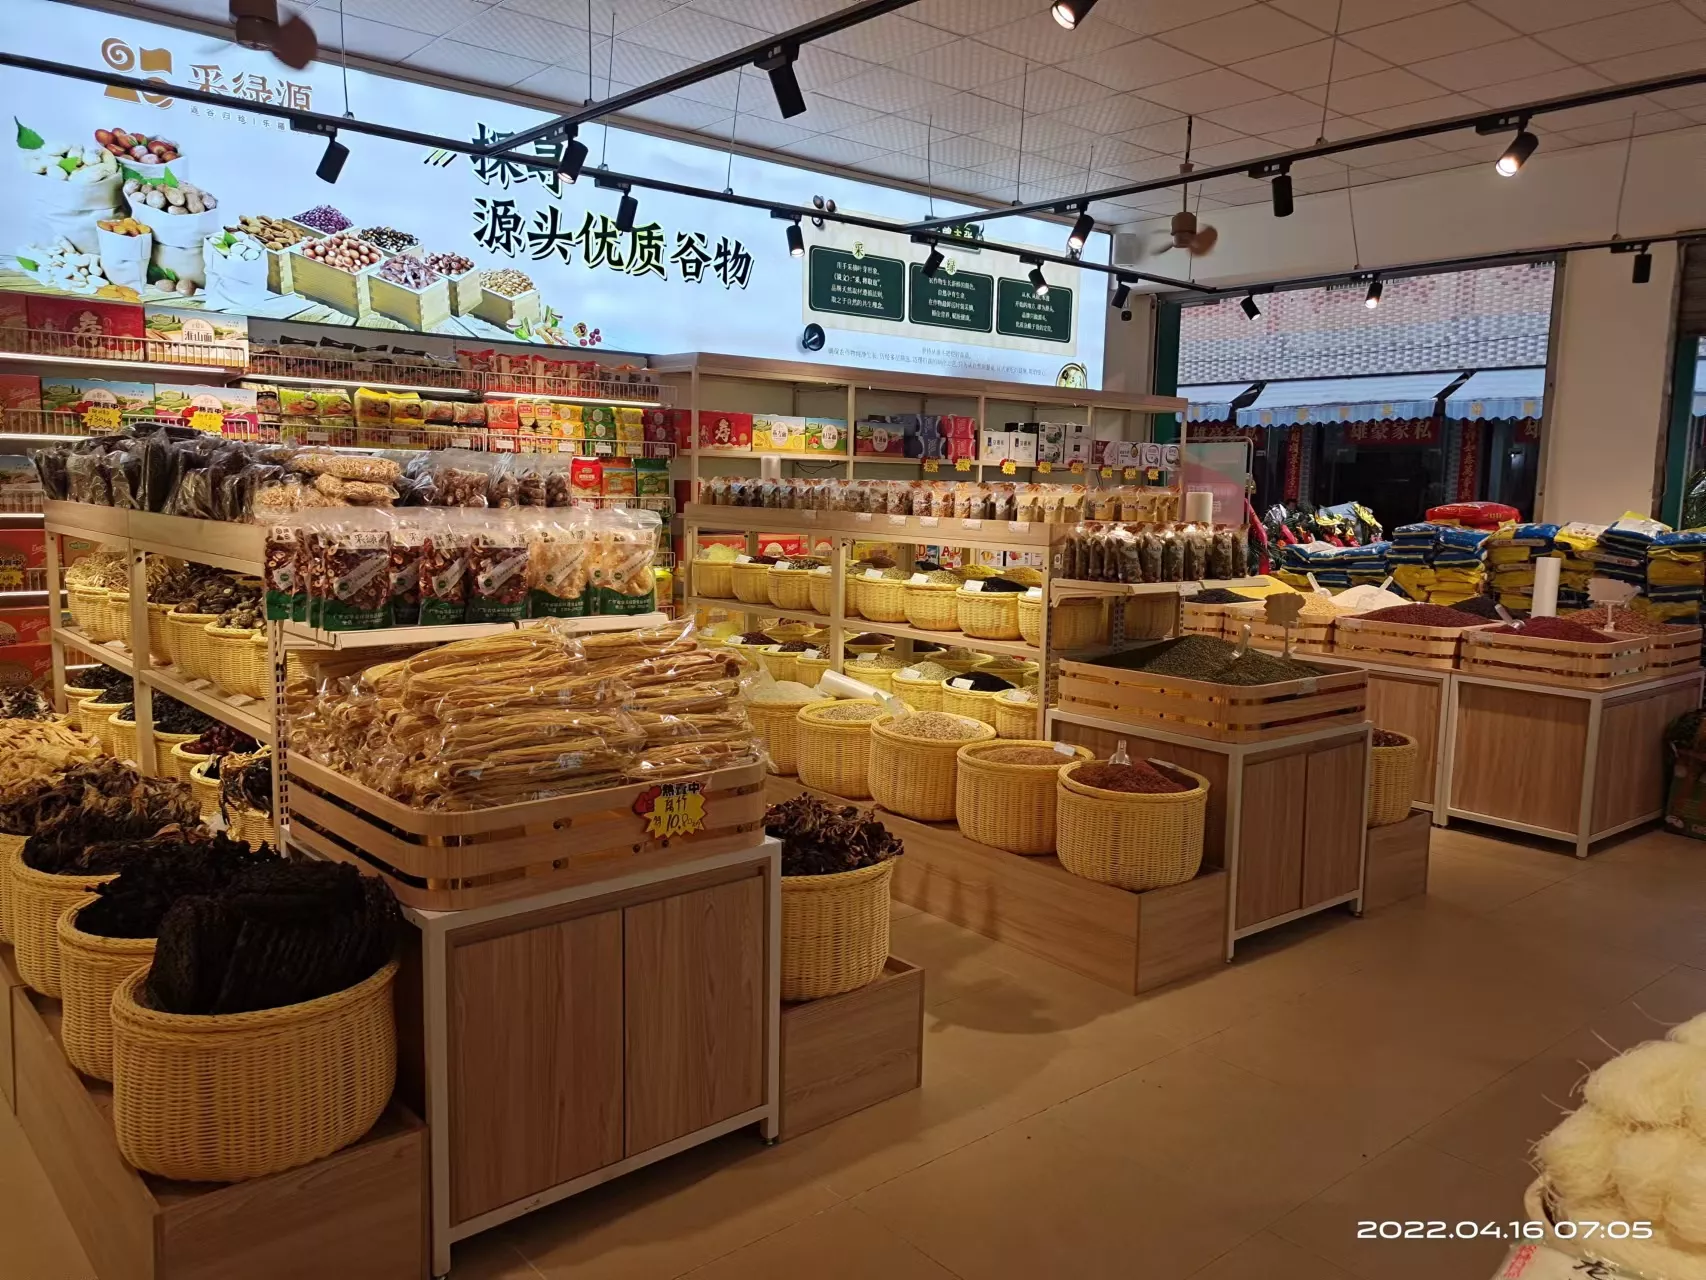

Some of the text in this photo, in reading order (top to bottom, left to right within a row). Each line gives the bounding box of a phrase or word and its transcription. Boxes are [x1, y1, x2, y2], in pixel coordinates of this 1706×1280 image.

[187, 64, 313, 111] 采绿源
[472, 197, 755, 289] 源头优质谷物
[854, 243, 864, 257] 采
